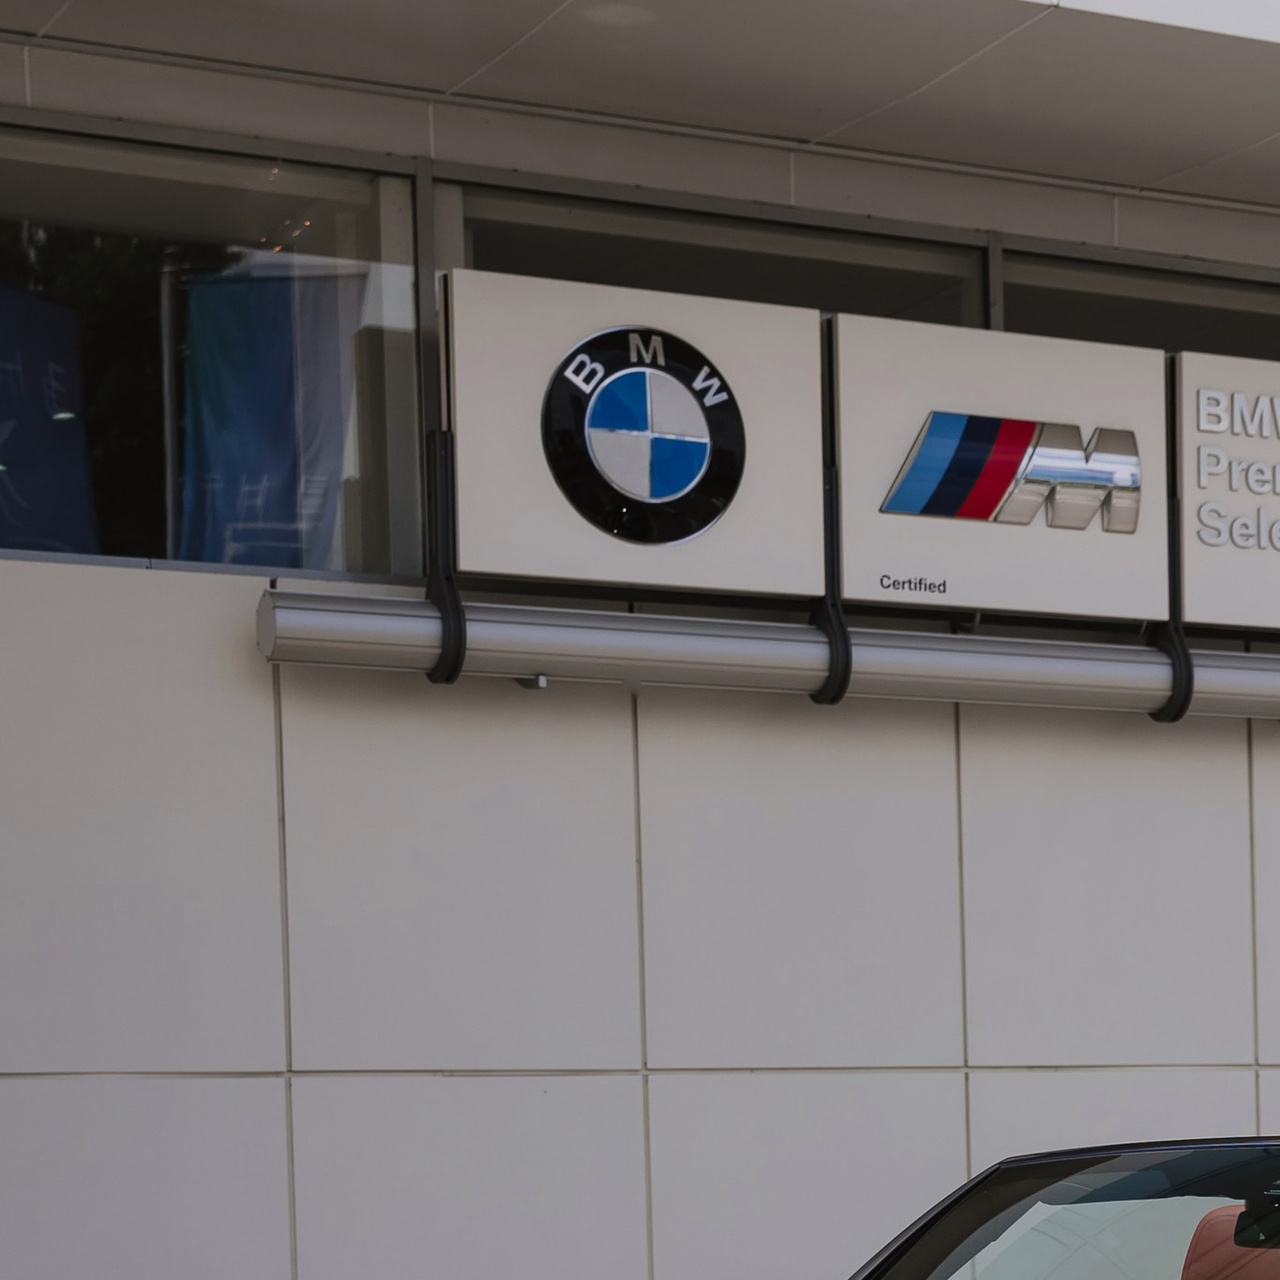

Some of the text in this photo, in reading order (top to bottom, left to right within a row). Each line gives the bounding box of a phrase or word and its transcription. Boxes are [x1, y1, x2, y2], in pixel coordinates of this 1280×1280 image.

[564, 332, 729, 408] BMW
[990, 421, 1142, 535] M
[879, 574, 947, 594] Certified
